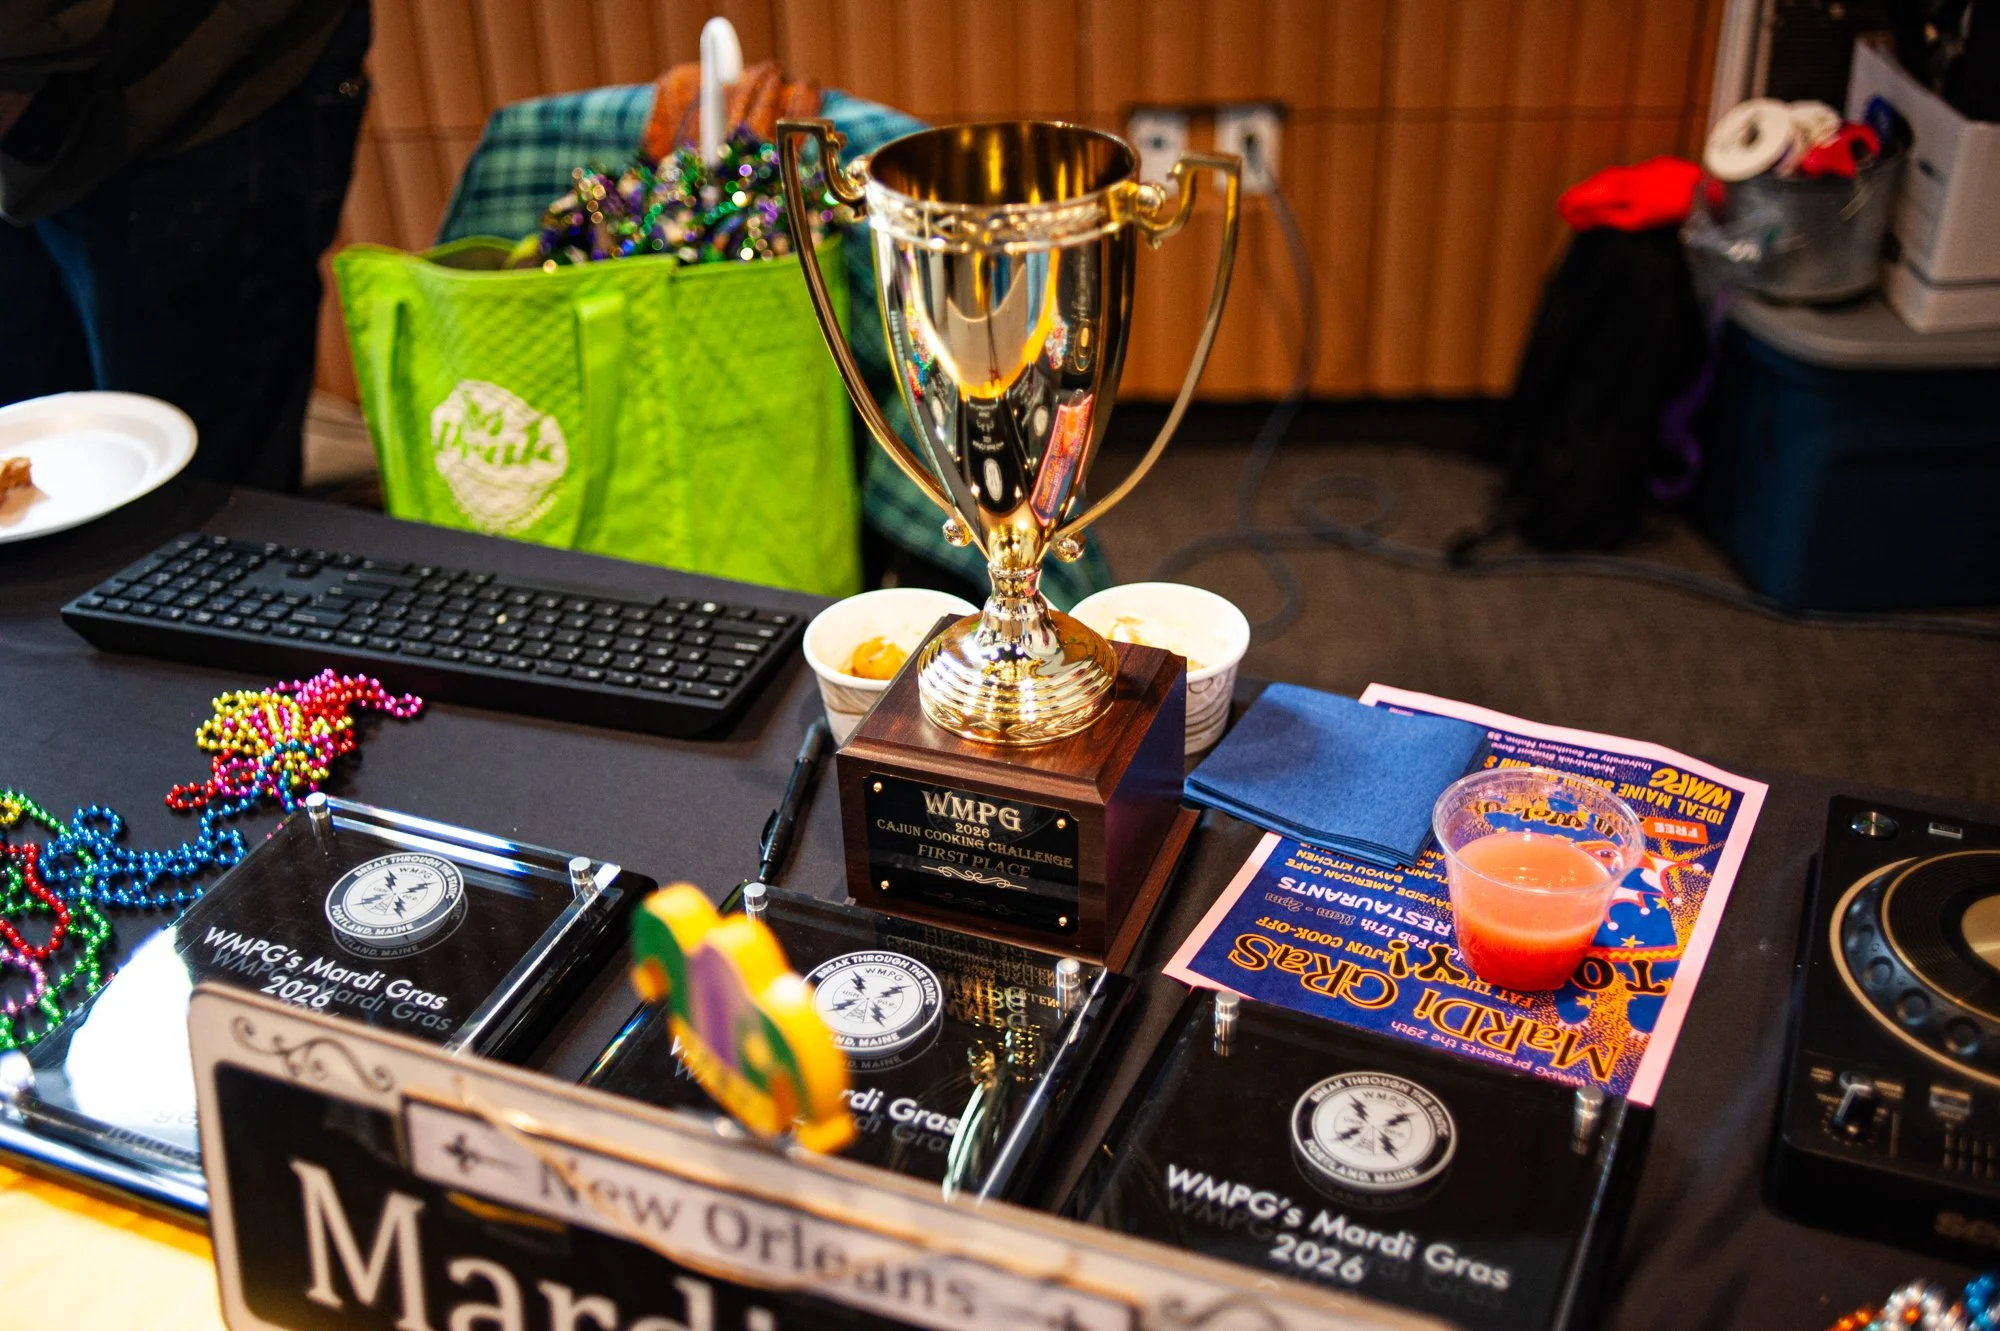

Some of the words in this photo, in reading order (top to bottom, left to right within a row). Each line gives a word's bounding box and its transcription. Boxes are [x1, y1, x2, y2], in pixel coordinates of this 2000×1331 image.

[1617, 782, 1672, 810] MAINE
[1649, 767, 1732, 810] WMPG
[921, 790, 1023, 833] WMPG
[1677, 798, 1726, 825] IDEAL
[955, 822, 990, 838] 2026
[1654, 822, 1698, 838] FREE
[876, 818, 921, 837] CAJUN
[924, 829, 985, 850] COOKING
[988, 842, 1074, 868] CHALLENGE
[354, 859, 388, 878] BREAK
[390, 856, 441, 868] THROUGH
[918, 844, 968, 864] FIRST
[971, 855, 1031, 878] PLACE
[1285, 858, 1322, 874] CAFE
[1296, 850, 1354, 871] KITCHEN
[400, 867, 432, 879] WMPG
[1324, 870, 1394, 892] AMERICAN
[1355, 866, 1404, 883] BAYOU
[1404, 868, 1448, 884] TLAND
[1264, 892, 1304, 912] 2pm
[1278, 876, 1452, 936] RESTAURANTS
[1396, 887, 1453, 910] BAYSIDE
[331, 904, 372, 936] PORTLAND,
[375, 923, 414, 936] MAINE
[1255, 915, 1343, 948] COOK-OFF
[1360, 918, 1395, 938] 17th
[1345, 940, 1393, 963] AJUN
[1398, 932, 1429, 950] Feb
[202, 926, 302, 970] WMPG's
[303, 956, 387, 992] Mardi
[385, 978, 448, 1010] Gras
[864, 968, 904, 982] WMPG
[260, 974, 336, 1008] 2026
[816, 958, 852, 979] BREAK
[851, 954, 911, 970] THROUGH
[908, 962, 926, 980] THE
[921, 978, 936, 1006] STATIC
[1496, 990, 1534, 1008] FAT
[859, 1032, 900, 1048] MAINE
[1391, 1021, 1428, 1038] 29th
[1430, 1033, 1456, 1048] the
[1461, 1042, 1532, 1072] presents
[1309, 1080, 1346, 1102] BREAK
[1346, 1076, 1411, 1093] THROUGH
[840, 1087, 884, 1113] rdi
[888, 1097, 960, 1136] Gras
[540, 1155, 682, 1234] New
[705, 1200, 977, 1317] Orleans
[1168, 1163, 1302, 1228] WMPG's
[1309, 1208, 1416, 1260] Mardi
[1423, 1242, 1512, 1291] Gras
[1269, 1233, 1365, 1284] 2026
